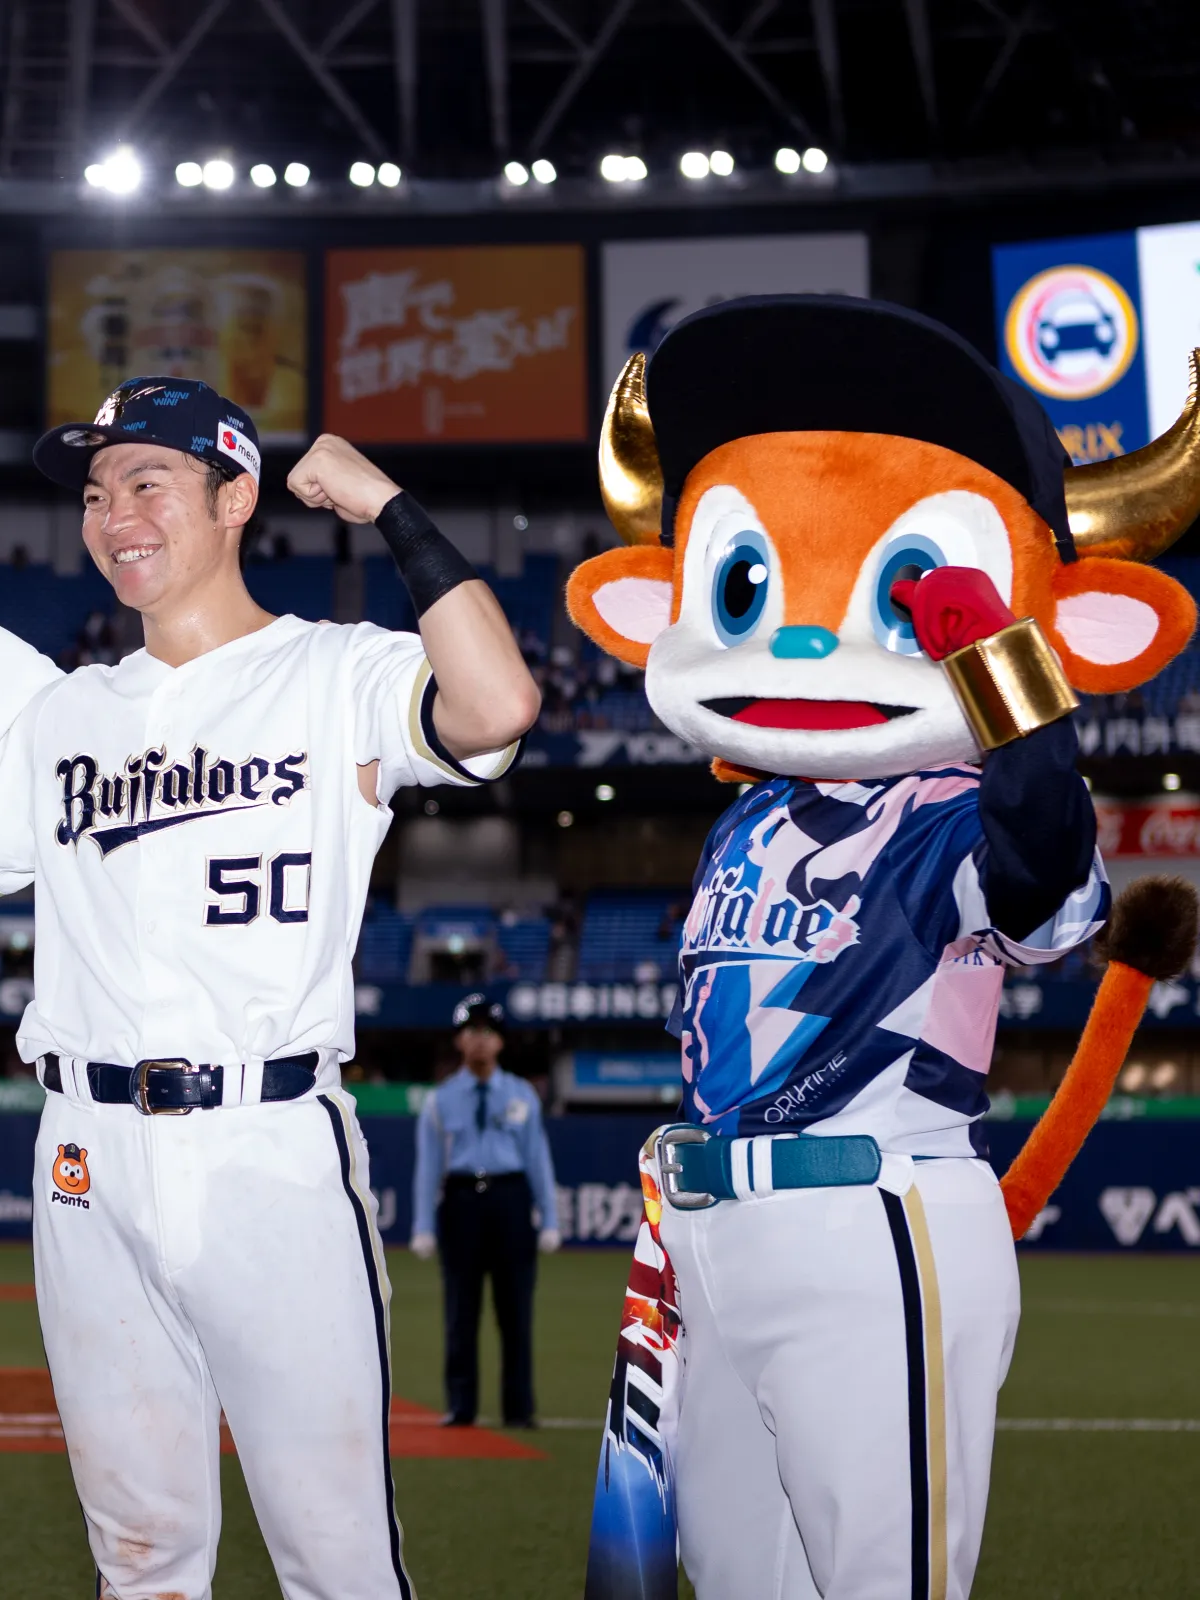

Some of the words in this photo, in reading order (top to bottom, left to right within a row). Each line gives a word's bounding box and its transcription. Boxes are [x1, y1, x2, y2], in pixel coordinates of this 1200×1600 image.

[153, 398, 179, 406] WIN!
[163, 390, 189, 400] WIN!
[1055, 421, 1126, 459] RIX
[54, 742, 313, 858] Buffaloes
[202, 849, 313, 928] 50
[764, 1050, 848, 1123] ORIHIME
[51, 1191, 90, 1210] Ponta
